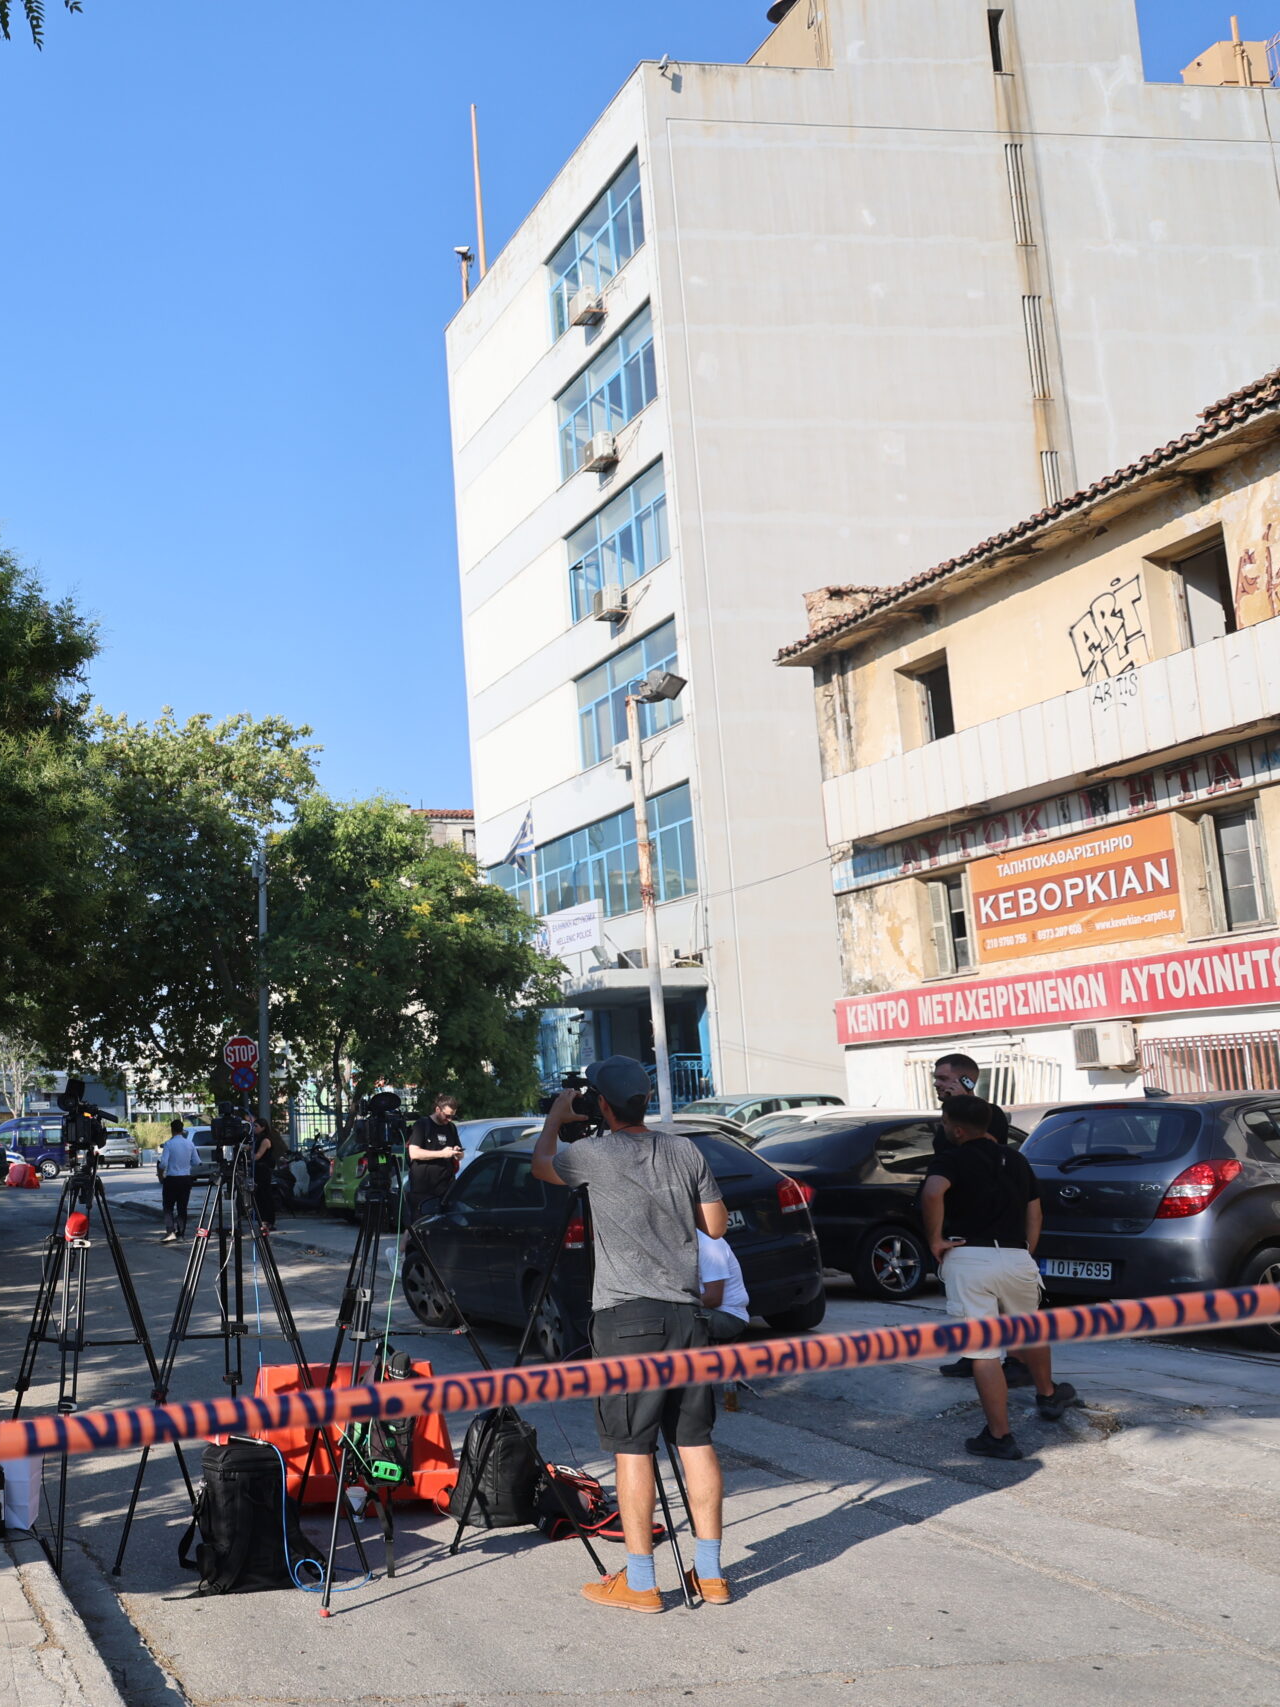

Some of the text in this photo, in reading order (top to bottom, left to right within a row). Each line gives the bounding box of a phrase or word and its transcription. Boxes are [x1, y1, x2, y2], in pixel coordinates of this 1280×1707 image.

[996, 834, 1133, 877] ΤΑΠΗΤΟΚΑΘΑΡΙΣΤΗΡΙΟ
[978, 857, 1172, 924] ΚΕΒΟΡΚΙΑΝ
[846, 999, 910, 1034] ΚΕΝΤΡΟ
[919, 972, 1108, 1027] ΜΕΤΑΧΕΙΡΙΣΜΕΝΩΝ
[226, 1044, 255, 1062] STOP
[412, 1366, 589, 1413] ΕΙΣΟΔΟΣ
